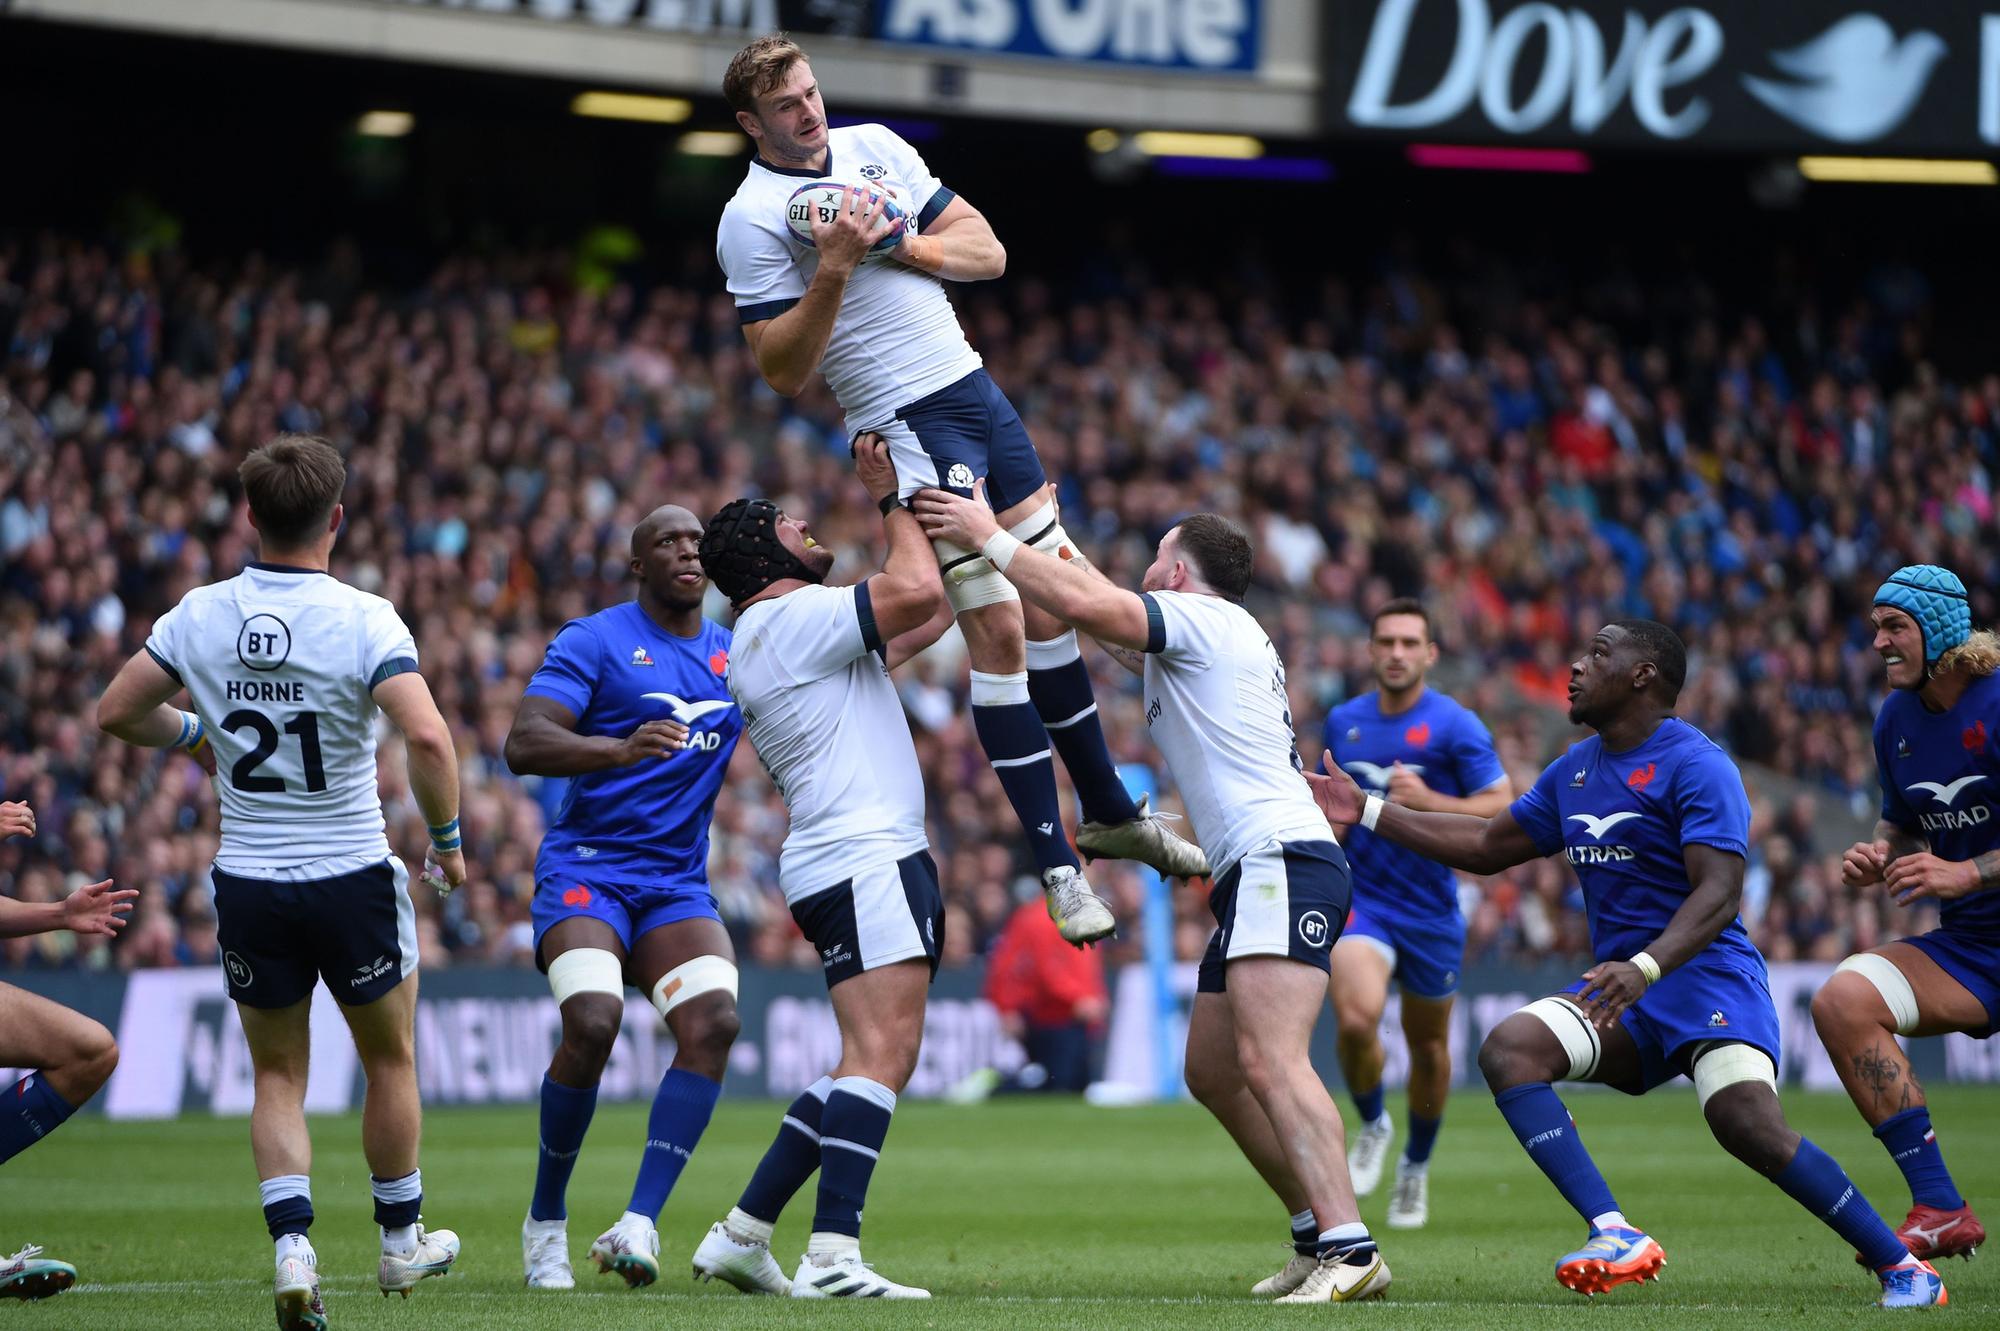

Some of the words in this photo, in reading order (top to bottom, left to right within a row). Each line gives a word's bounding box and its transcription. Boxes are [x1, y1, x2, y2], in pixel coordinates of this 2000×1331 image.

[1347, 0, 1725, 139] Dove
[248, 632, 278, 656] BT
[226, 680, 304, 702] HORNE
[220, 709, 327, 793] 21
[1919, 805, 1991, 832] ALTRAD
[1306, 919, 1324, 937] BT
[229, 960, 246, 977] BT
